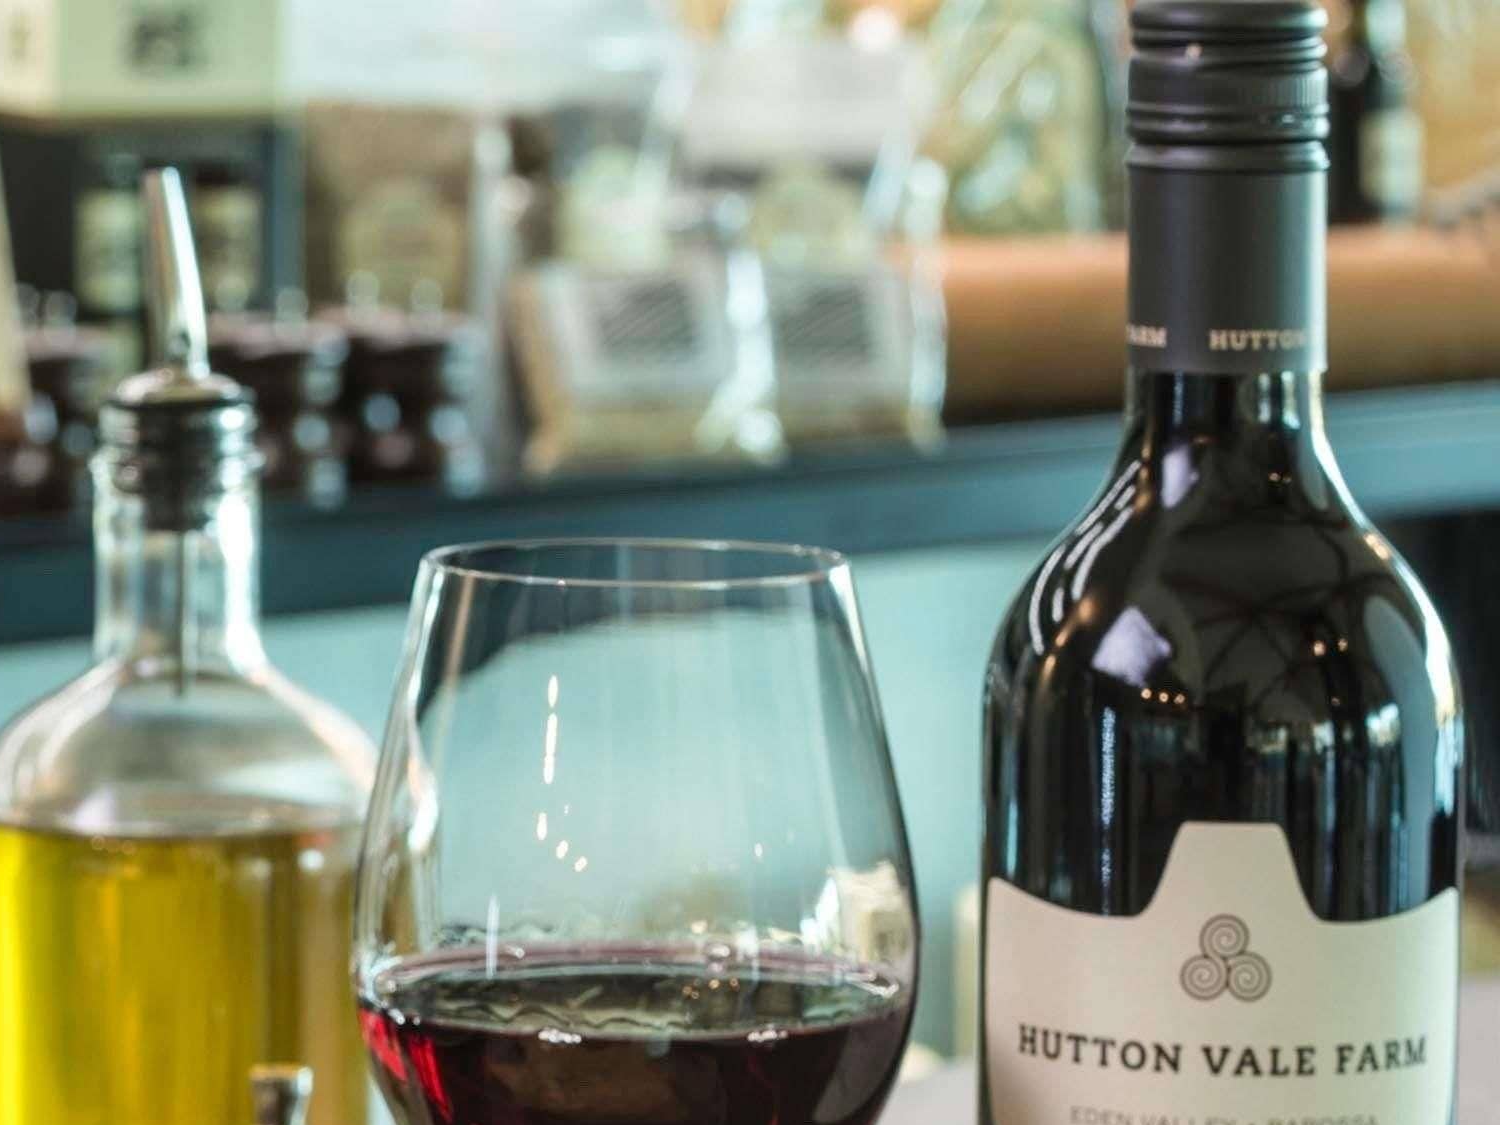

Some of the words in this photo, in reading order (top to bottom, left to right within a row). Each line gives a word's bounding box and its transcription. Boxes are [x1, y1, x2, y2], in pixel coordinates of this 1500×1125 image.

[1126, 323, 1167, 348] ARM
[1019, 1024, 1182, 1074] HUTTON
[1202, 1045, 1317, 1077] VALE
[1335, 1034, 1426, 1076] FARM
